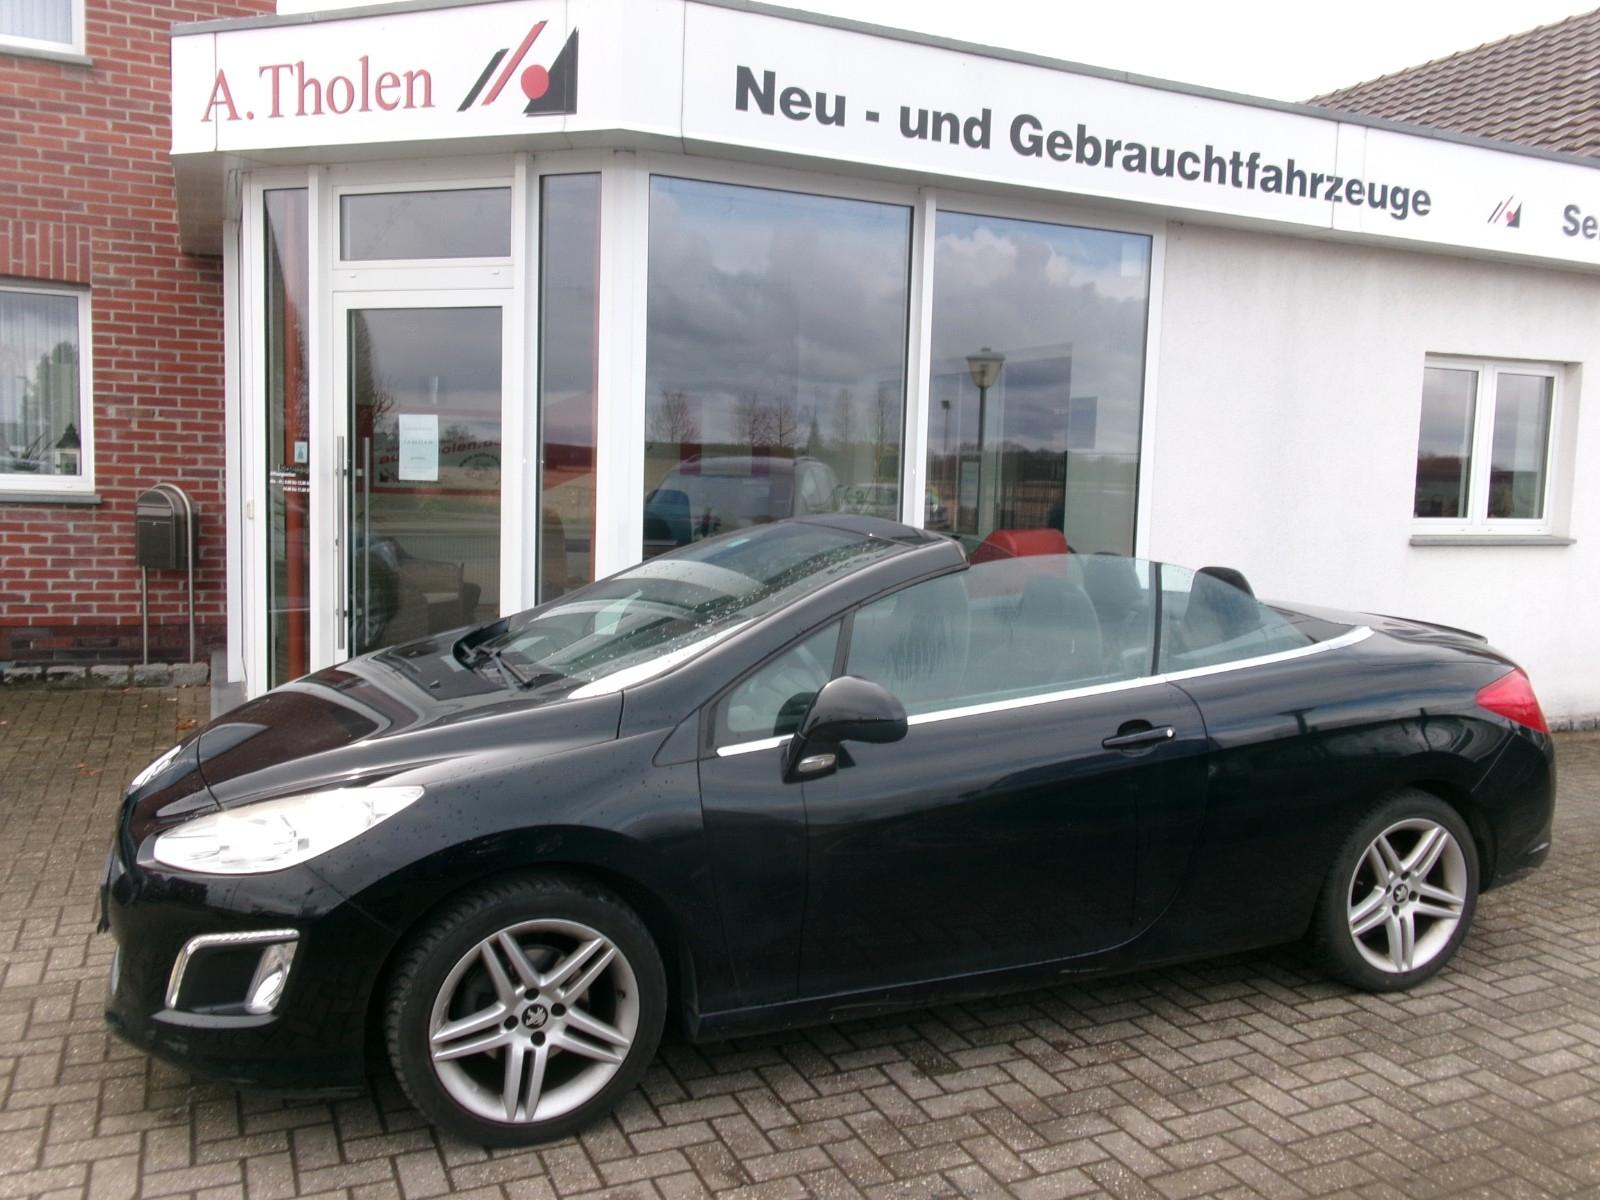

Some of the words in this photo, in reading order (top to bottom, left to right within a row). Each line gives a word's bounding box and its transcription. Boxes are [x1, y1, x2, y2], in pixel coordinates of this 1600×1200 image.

[735, 64, 847, 128] Neu
[899, 106, 992, 150] und
[1009, 113, 1432, 221] Gebrauchtfahrzeuge
[1562, 203, 1600, 241] Se
